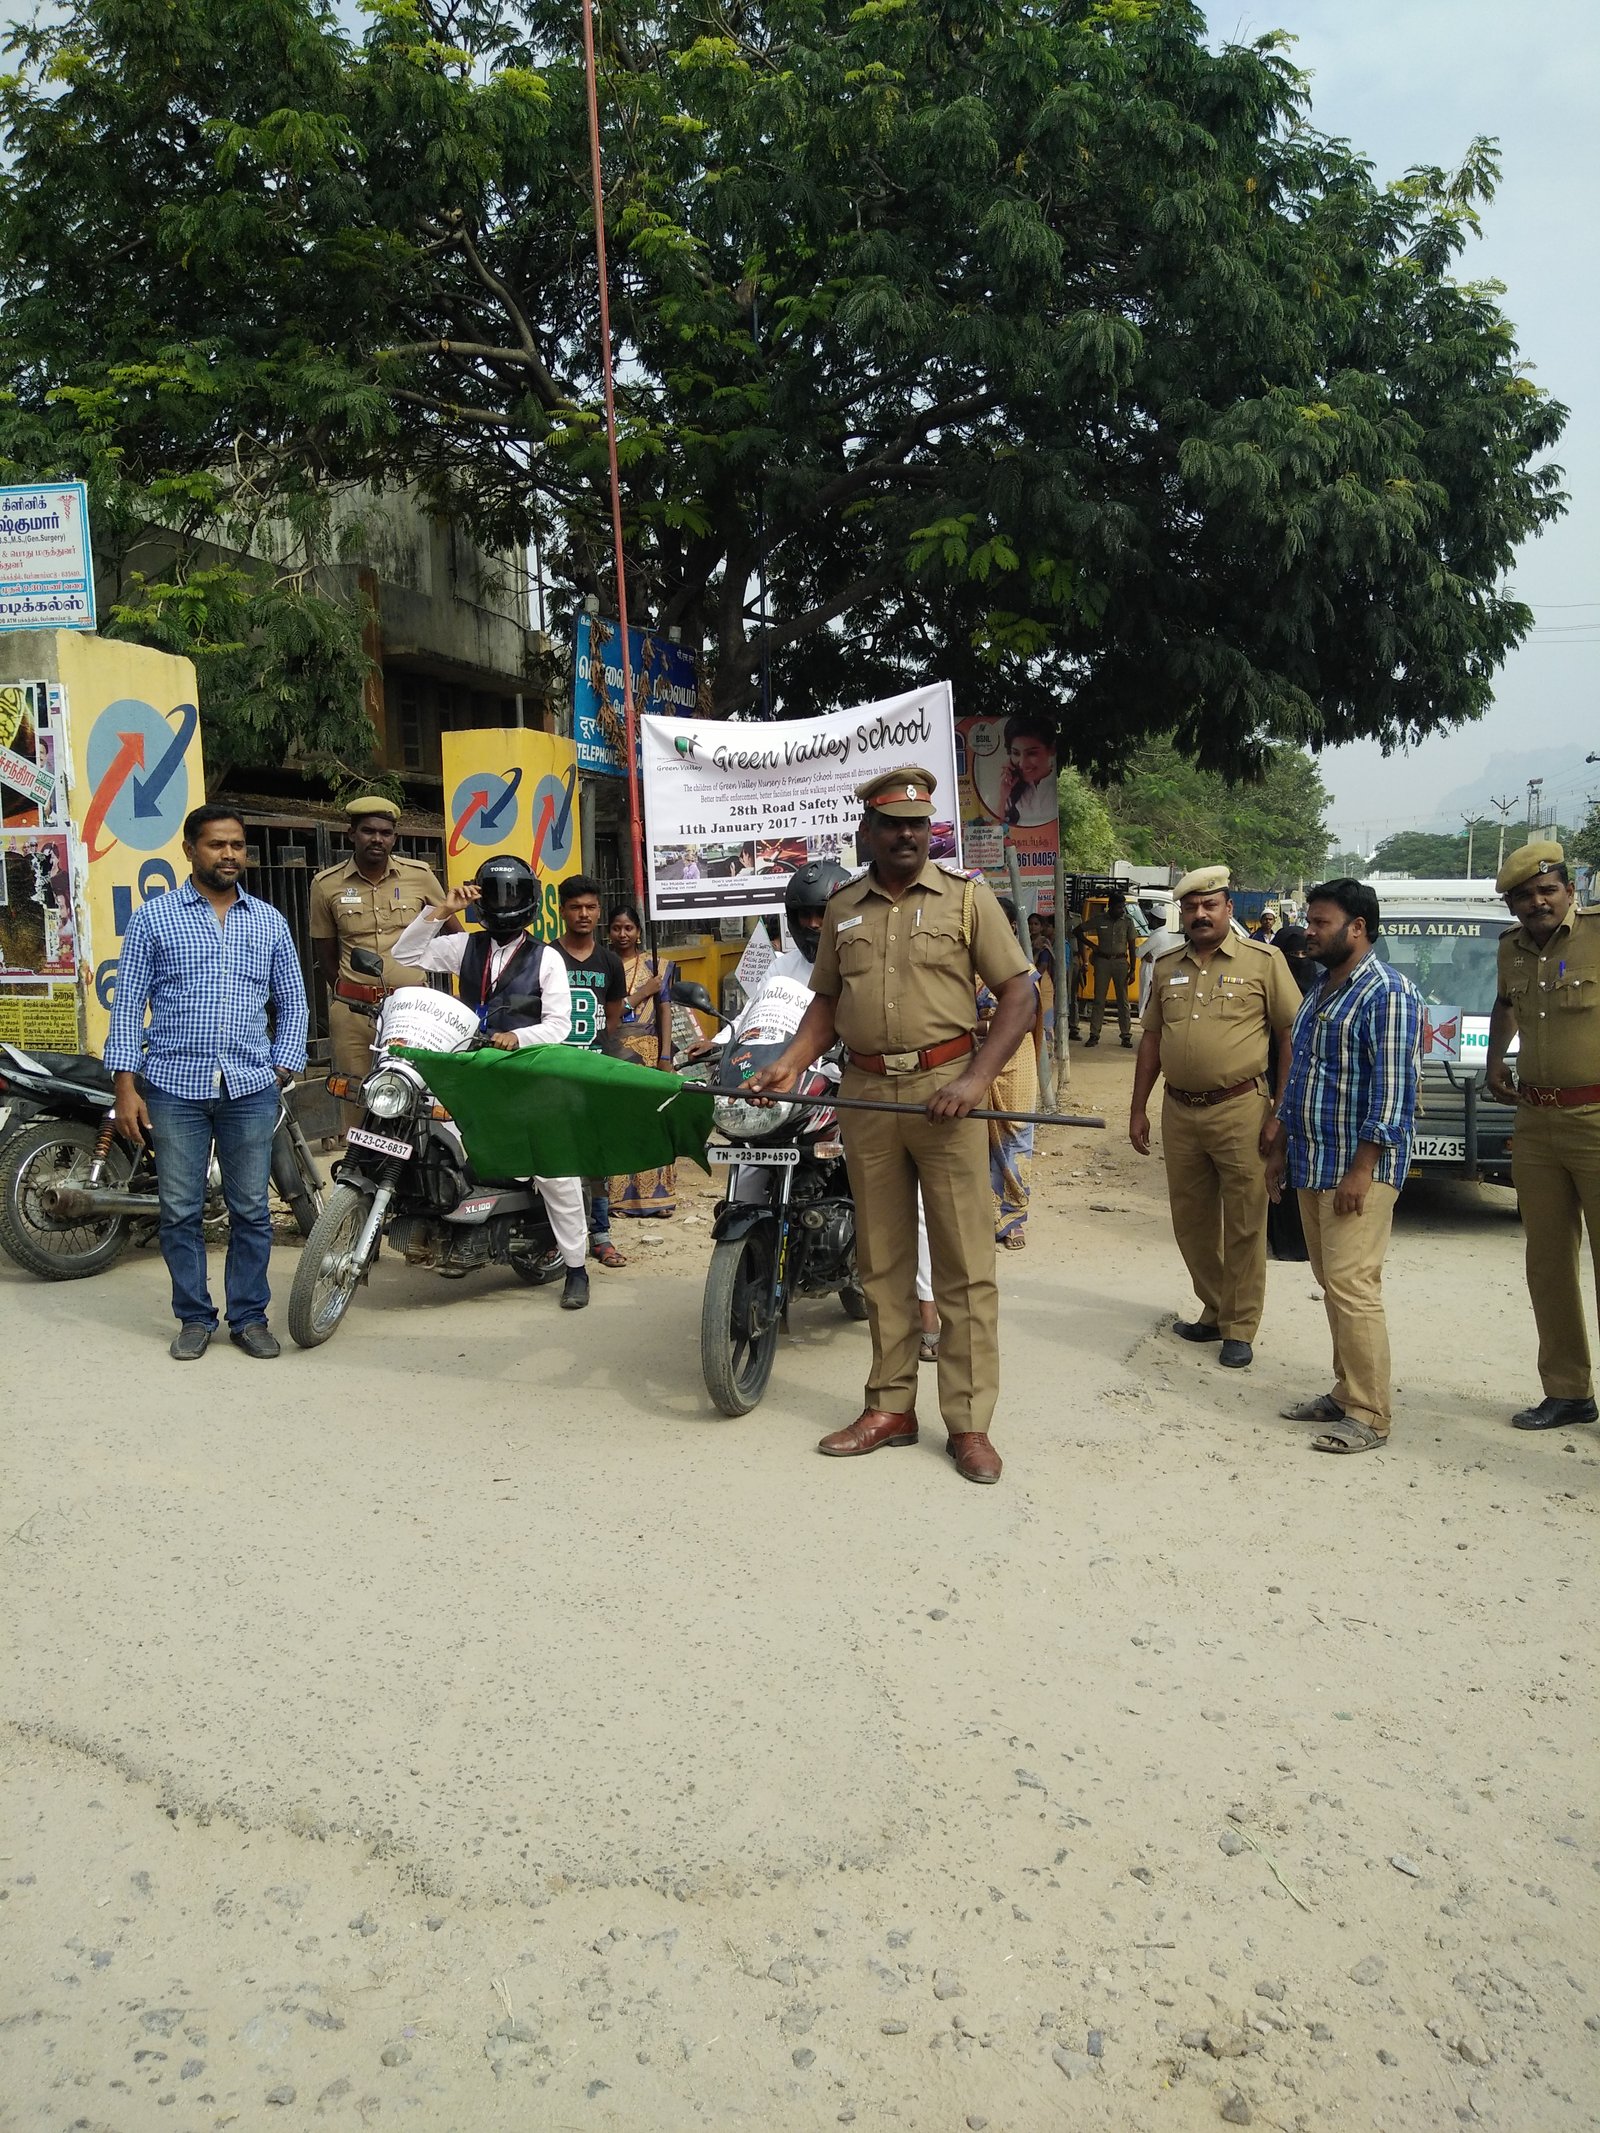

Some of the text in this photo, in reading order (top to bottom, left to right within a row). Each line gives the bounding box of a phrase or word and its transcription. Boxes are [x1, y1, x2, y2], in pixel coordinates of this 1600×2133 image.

[2, 495, 47, 512] கிளினிக்
[712, 707, 932, 773] Green Valley School
[679, 764, 703, 772] Valley
[684, 784, 692, 792] The
[693, 783, 712, 792] children
[713, 783, 718, 791] of
[718, 781, 737, 791] Green
[738, 779, 757, 791] Valley
[757, 778, 780, 789] Nursery
[781, 777, 787, 785] &
[788, 775, 812, 786] Primary
[813, 771, 832, 782] School
[730, 804, 757, 816] 28th
[762, 801, 795, 814] Road
[799, 798, 838, 811] Safety
[679, 824, 707, 835] 11th
[711, 822, 764, 833] January
[768, 817, 798, 830] 2017
[812, 814, 838, 826] 17th
[842, 812, 865, 822] Jan
[1425, 924, 1481, 936] ALLAH
[762, 986, 793, 1004] Valley
[414, 999, 446, 1021] Valley
[445, 1011, 471, 1037] School
